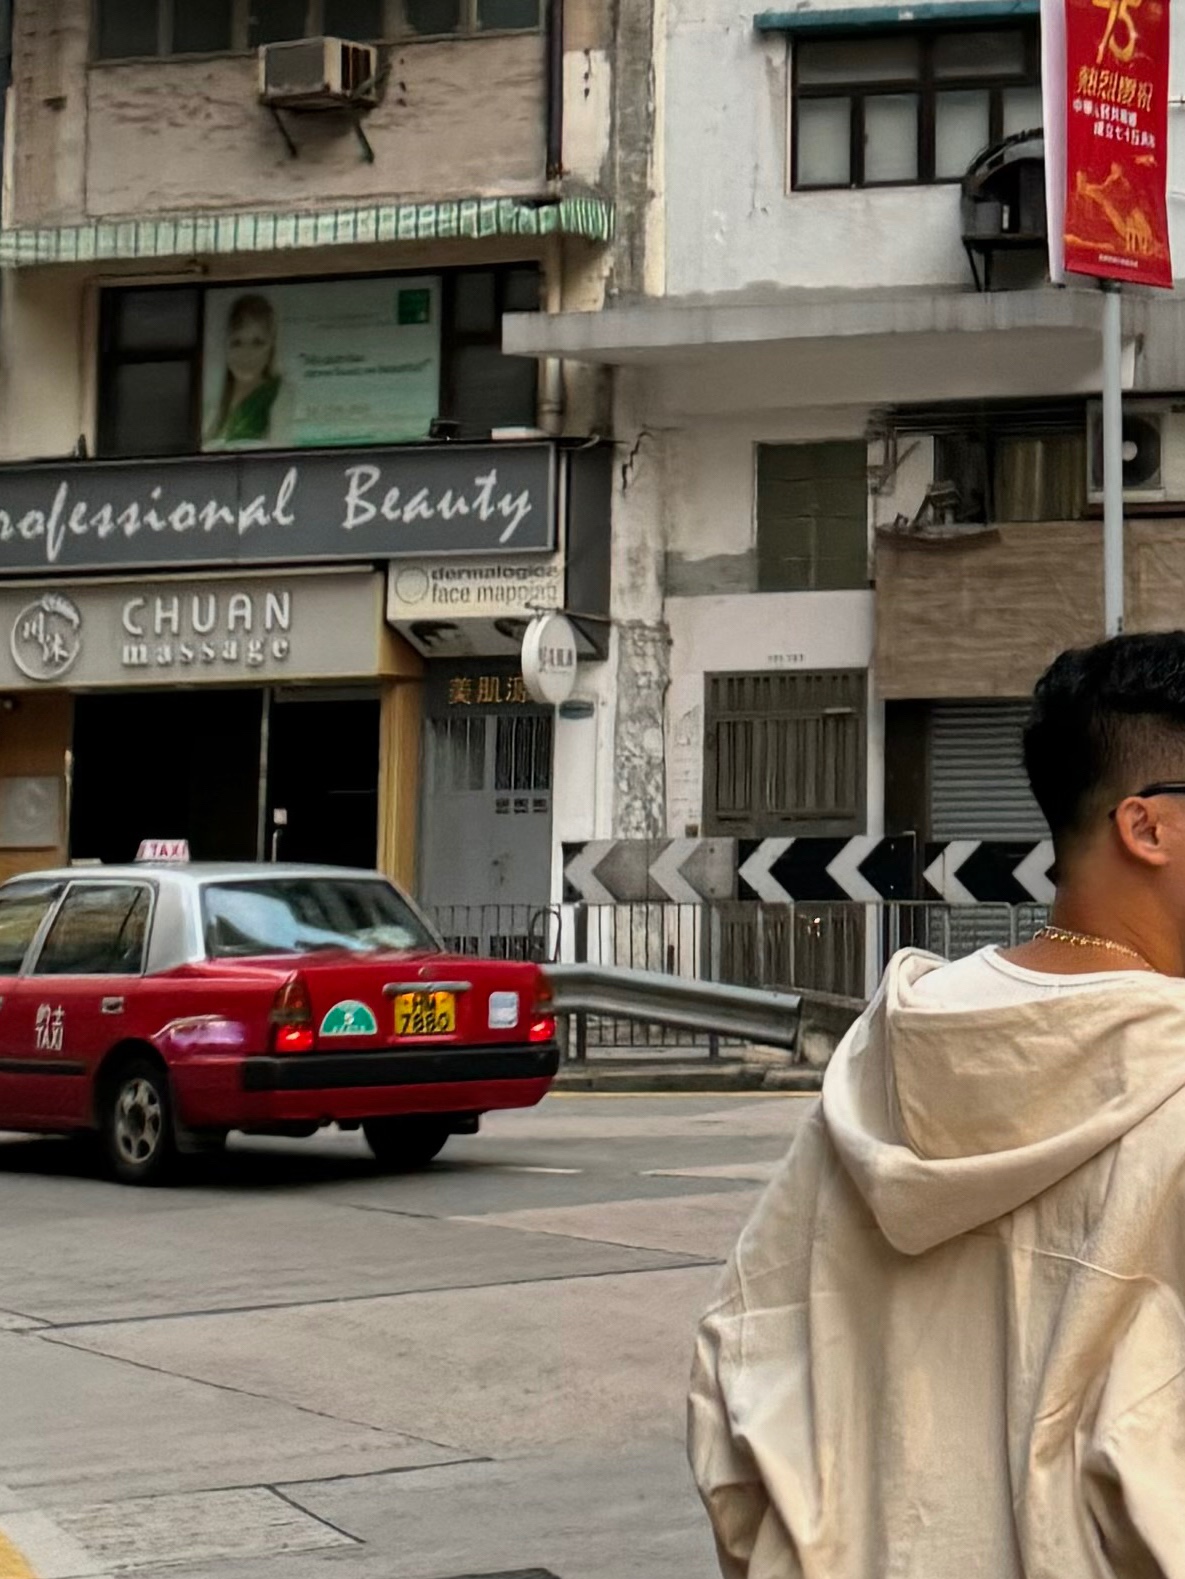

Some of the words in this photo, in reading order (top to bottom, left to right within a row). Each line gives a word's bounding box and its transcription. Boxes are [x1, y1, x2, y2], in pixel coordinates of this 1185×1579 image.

[341, 464, 532, 543] Beauty
[431, 565, 557, 581] dermalogica
[432, 582, 471, 604] face
[121, 591, 291, 636] CHUAN
[121, 638, 290, 666] massage
[149, 843, 187, 857] TAXI
[35, 1026, 64, 1051] TAXI
